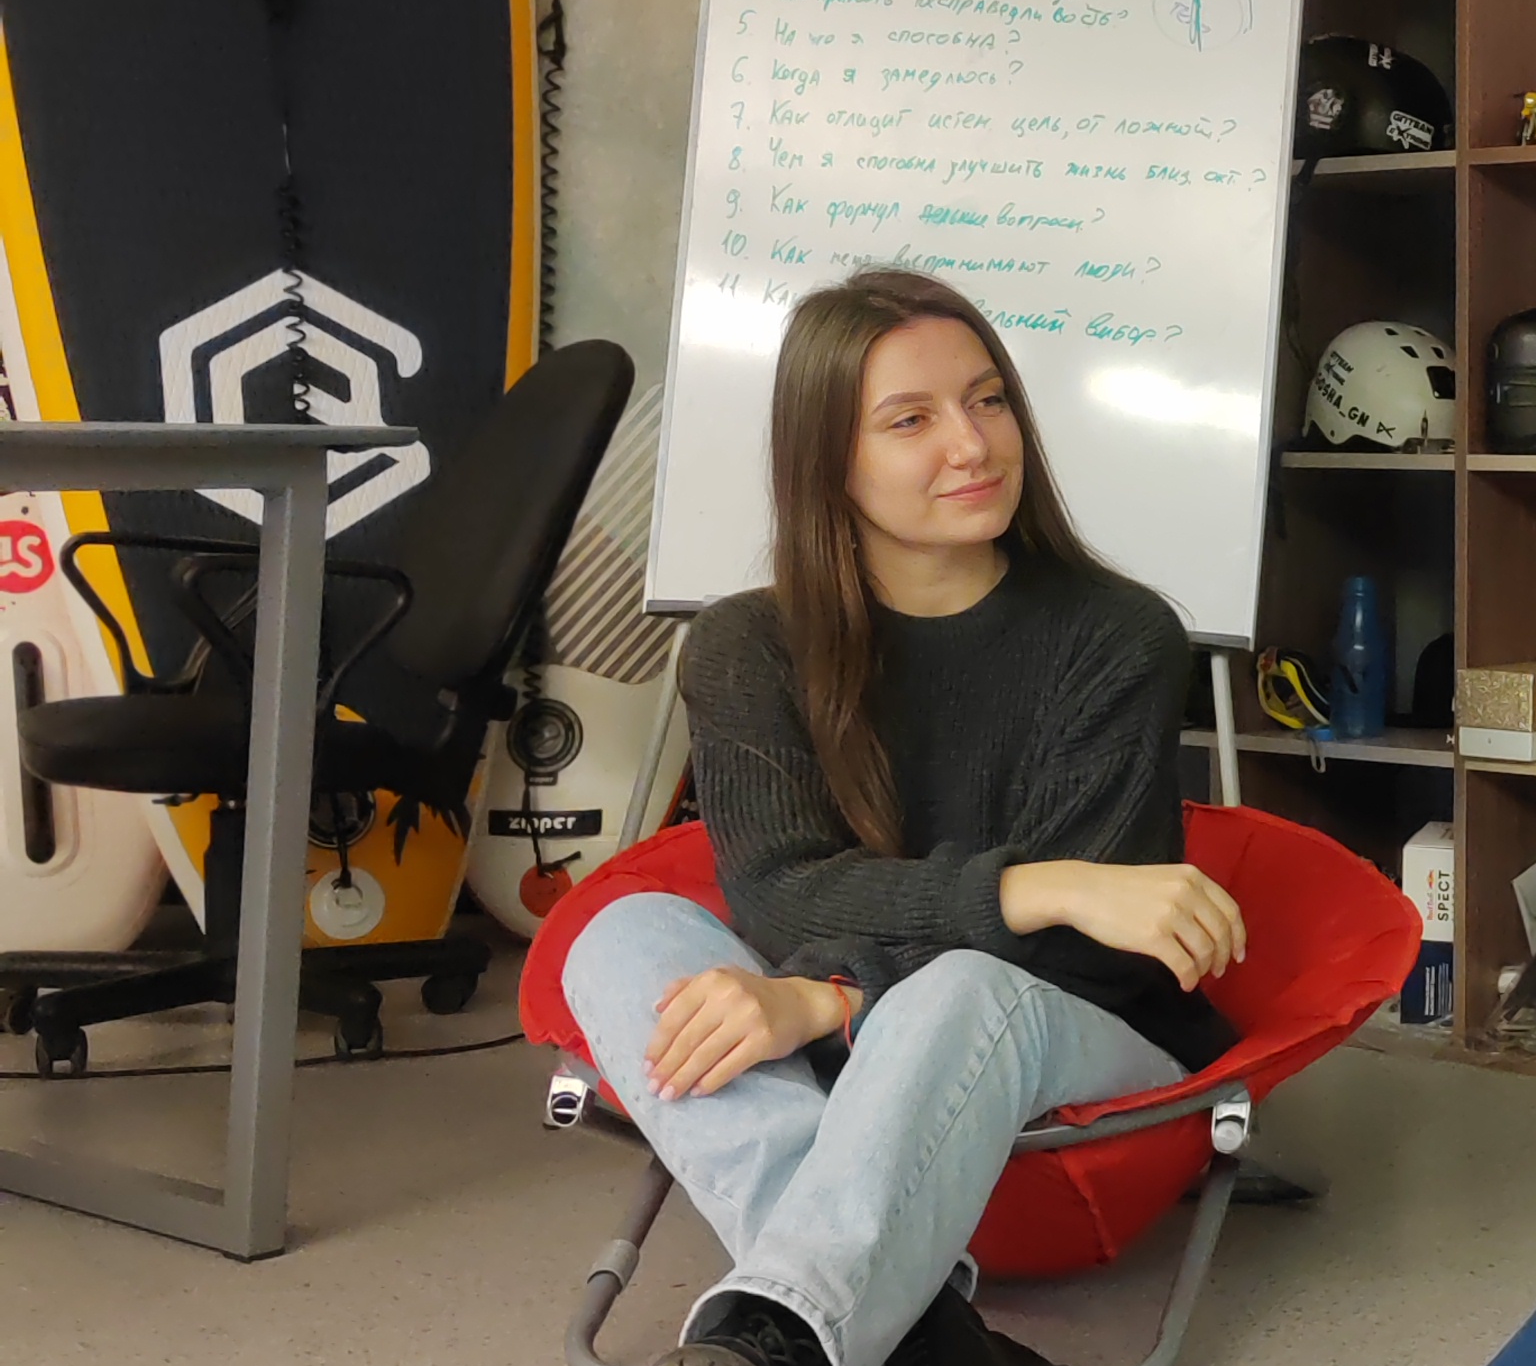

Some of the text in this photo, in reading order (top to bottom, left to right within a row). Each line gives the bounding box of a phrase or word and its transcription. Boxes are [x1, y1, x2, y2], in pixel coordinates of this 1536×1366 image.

[842, 67, 857, 84] я
[819, 151, 834, 168] я
[508, 815, 577, 834] zipper
[1437, 869, 1451, 922] SPECT
